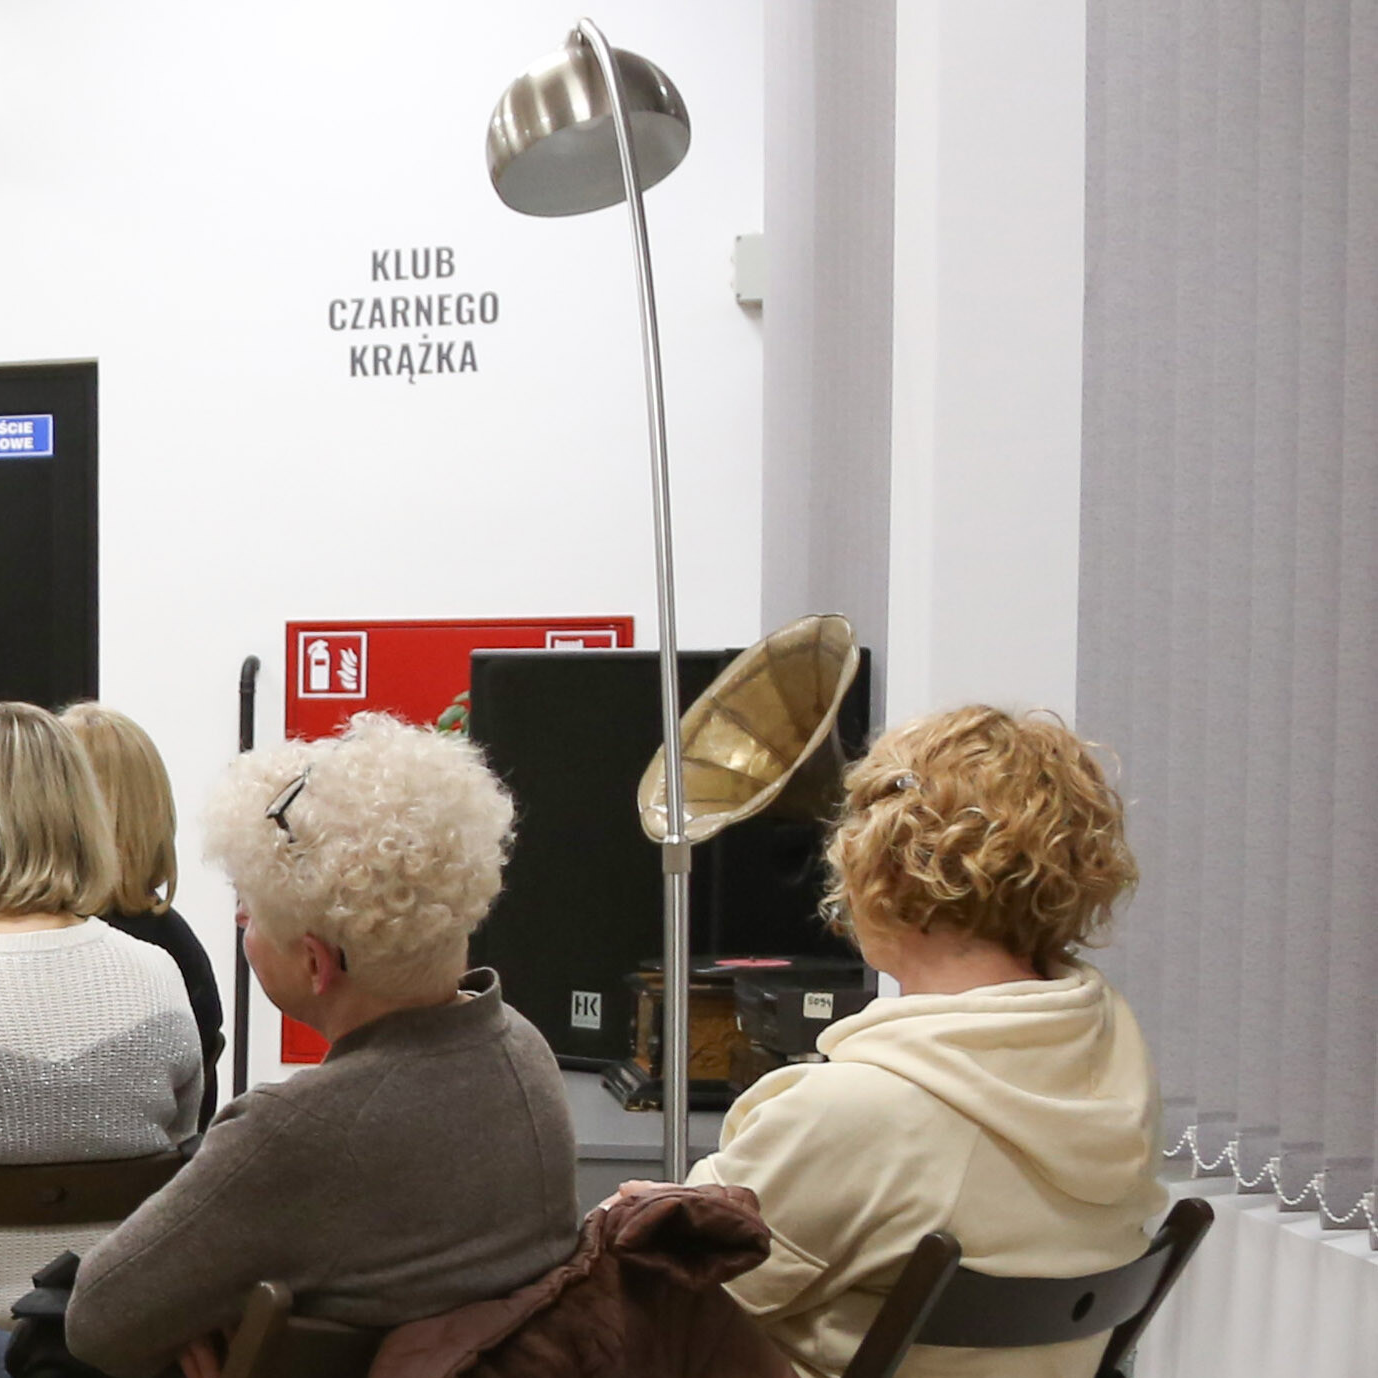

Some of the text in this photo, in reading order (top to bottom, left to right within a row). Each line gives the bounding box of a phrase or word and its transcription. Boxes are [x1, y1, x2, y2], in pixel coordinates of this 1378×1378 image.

[371, 246, 455, 282] KLUB
[328, 291, 500, 331] CZARNEGO
[349, 333, 479, 385] KRĄŻKA
